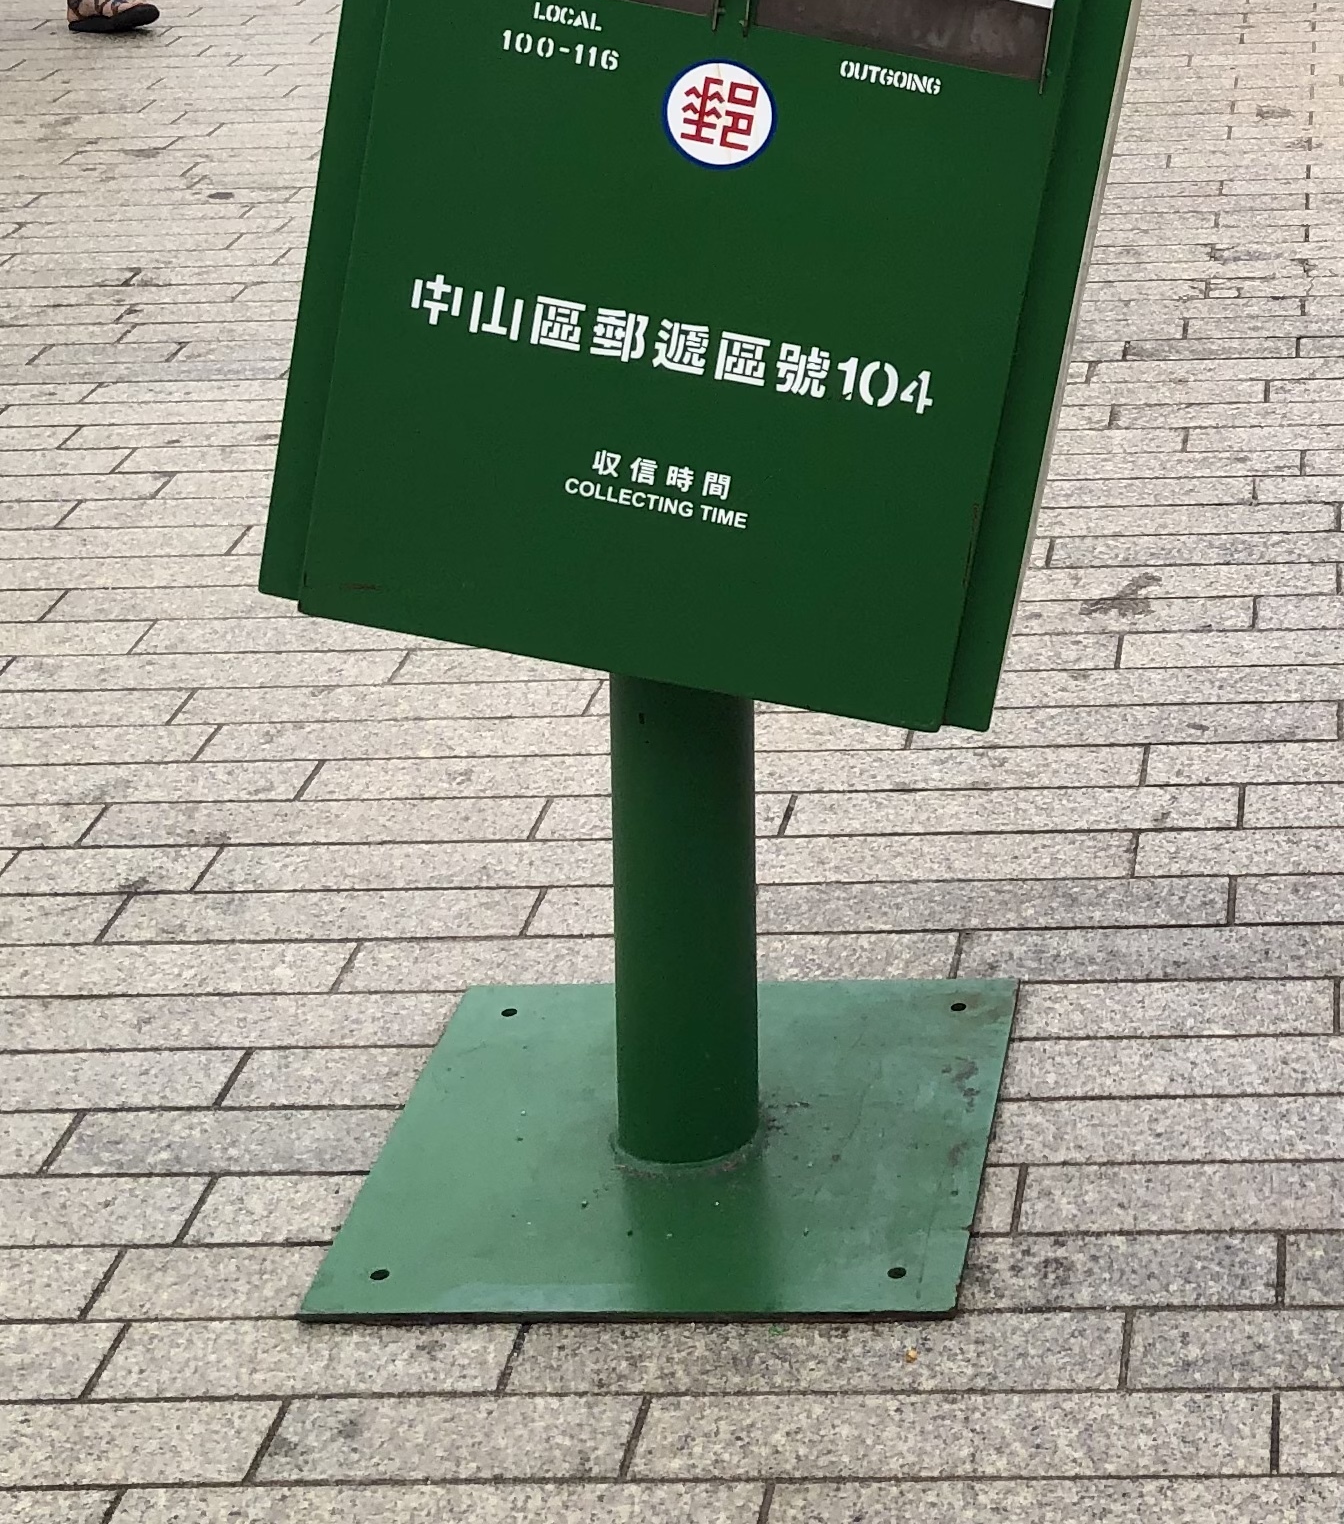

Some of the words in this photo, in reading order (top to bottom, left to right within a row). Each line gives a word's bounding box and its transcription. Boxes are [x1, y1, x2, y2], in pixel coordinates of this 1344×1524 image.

[533, 1, 602, 31] LOCAL
[502, 29, 620, 71] 100-116
[840, 60, 941, 95] OUTGOING
[411, 274, 933, 414] 中山區郵遞區號104
[564, 477, 694, 518] COLLECTING
[700, 504, 748, 529] TIME
